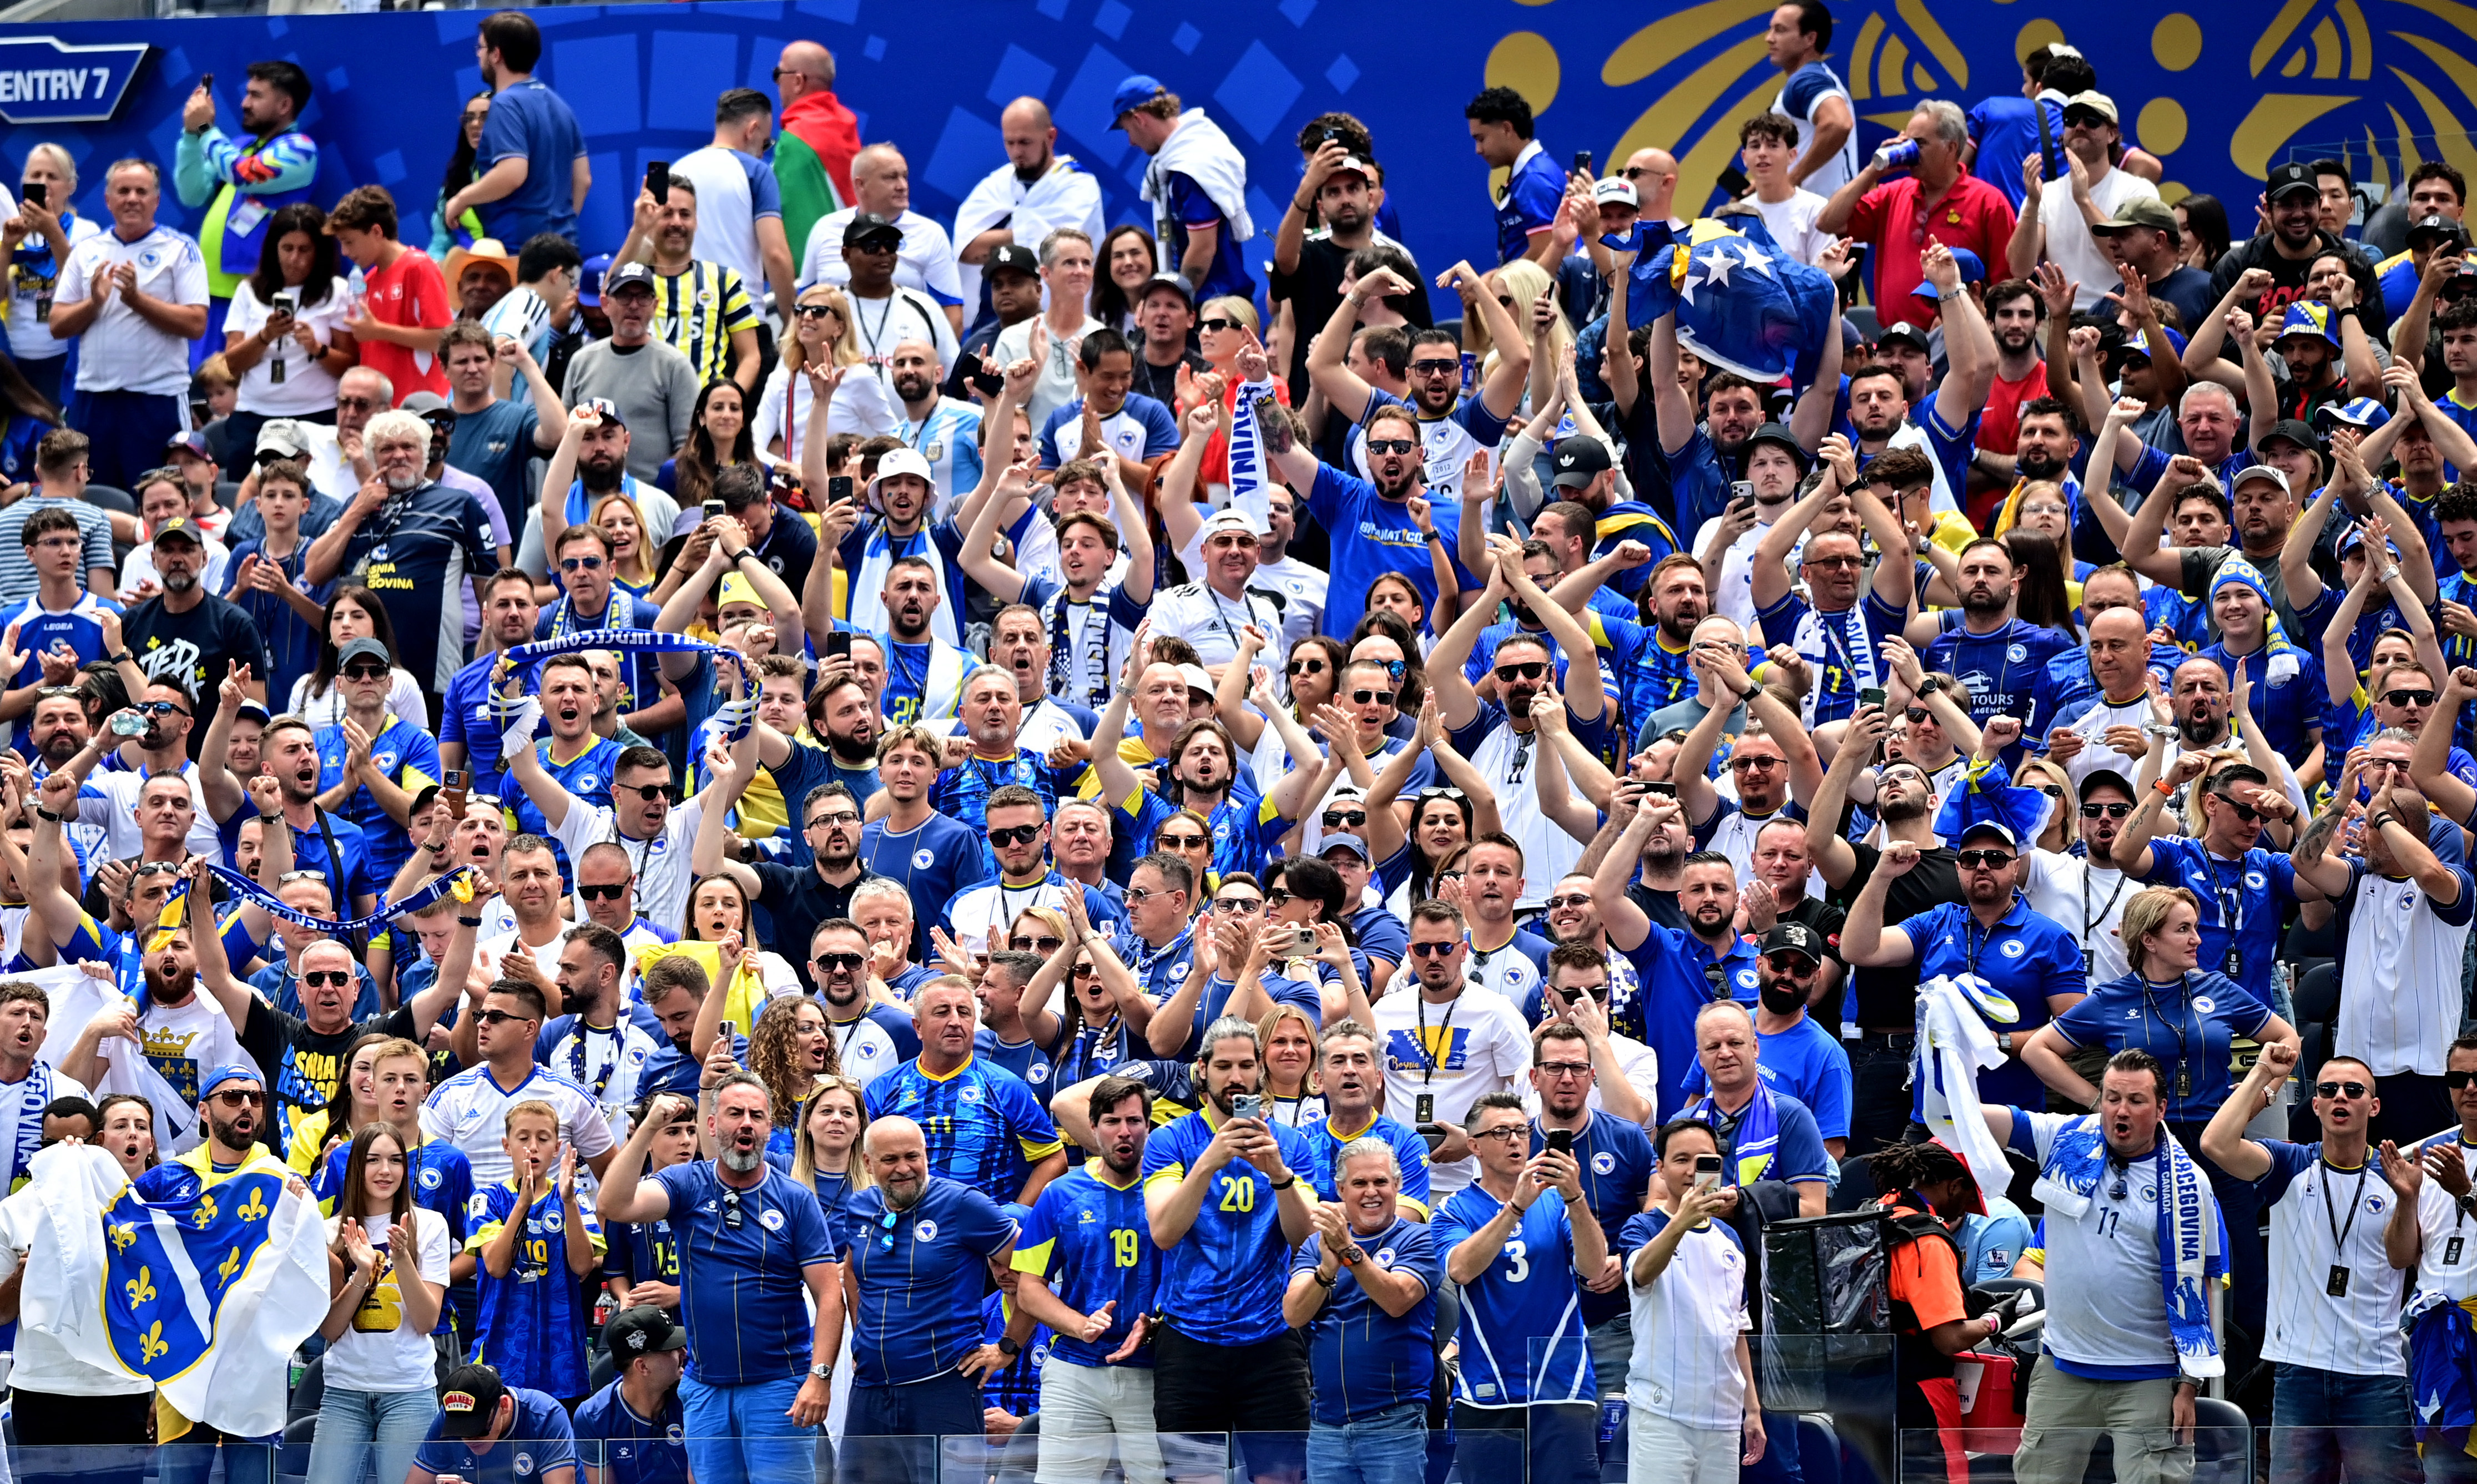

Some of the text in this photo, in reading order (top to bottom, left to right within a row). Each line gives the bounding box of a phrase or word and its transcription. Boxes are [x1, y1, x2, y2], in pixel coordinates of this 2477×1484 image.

[1, 68, 110, 103] ENTRY 7
[1435, 463, 1452, 473] 2012
[367, 563, 395, 574] SNIA
[43, 622, 72, 631] LEGEA
[1666, 678, 1682, 700] 7
[1970, 694, 2013, 705] TOURS
[1219, 1175, 1254, 1212] 20
[2161, 1171, 2172, 1214] CANADA
[2172, 1143, 2201, 1261] HERCEGOVINA
[1109, 1229, 1137, 1268] 19
[1504, 1240, 1530, 1283] 3
